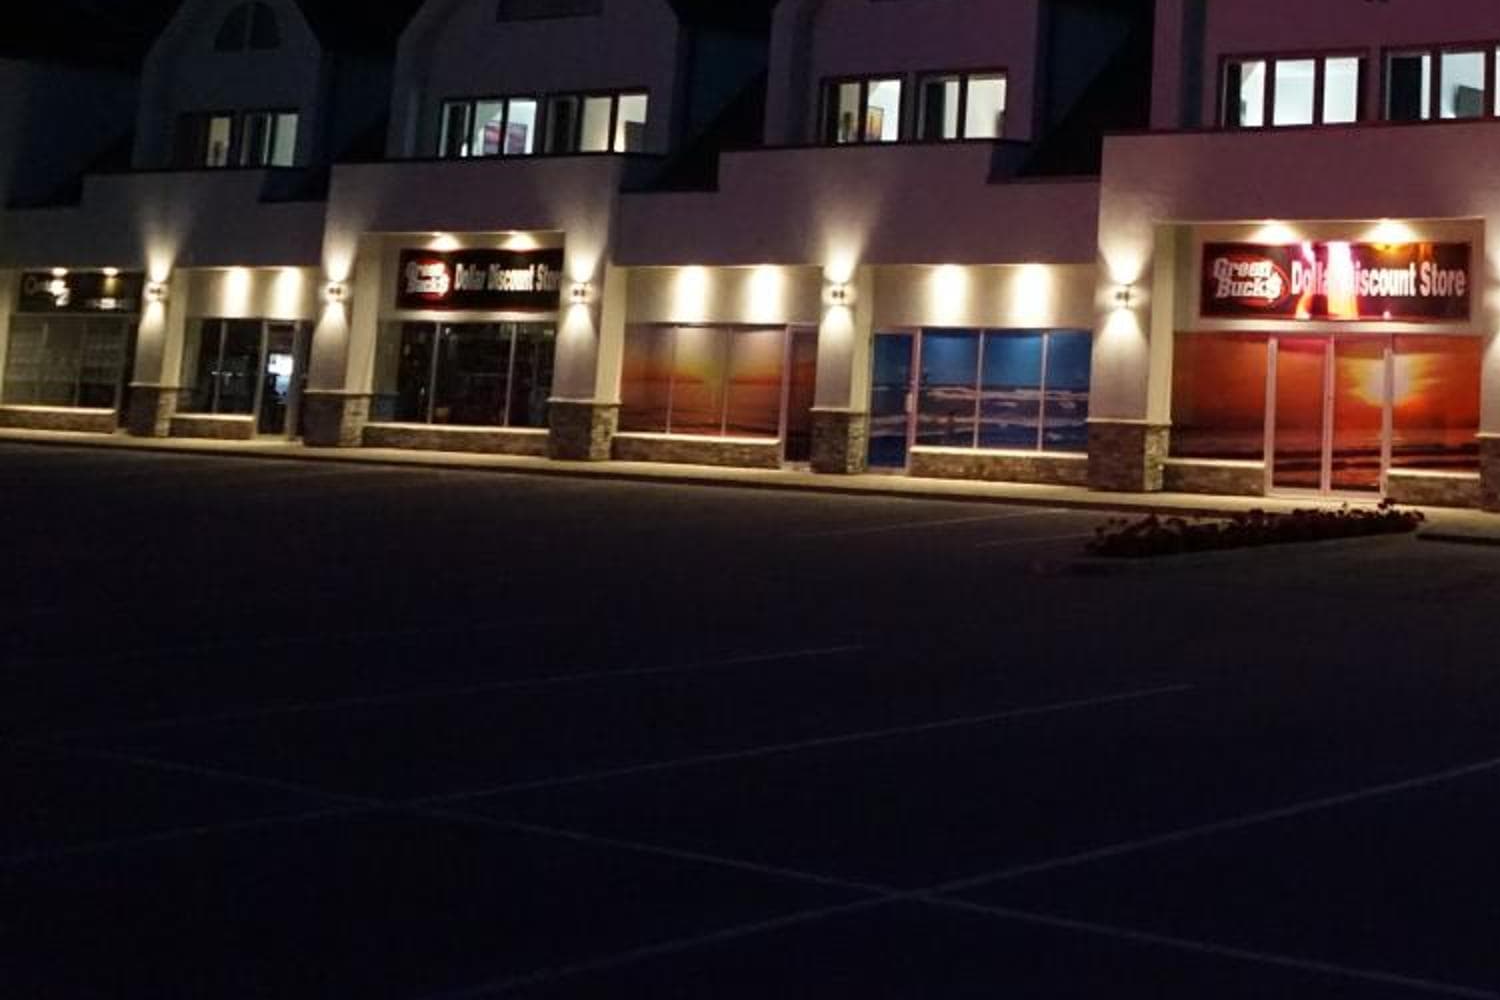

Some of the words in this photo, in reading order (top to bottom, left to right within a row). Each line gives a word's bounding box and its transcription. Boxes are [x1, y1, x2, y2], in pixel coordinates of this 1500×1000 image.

[1291, 261, 1342, 296] Dolla
[1345, 261, 1416, 296] iscount
[1420, 261, 1465, 297] Store
